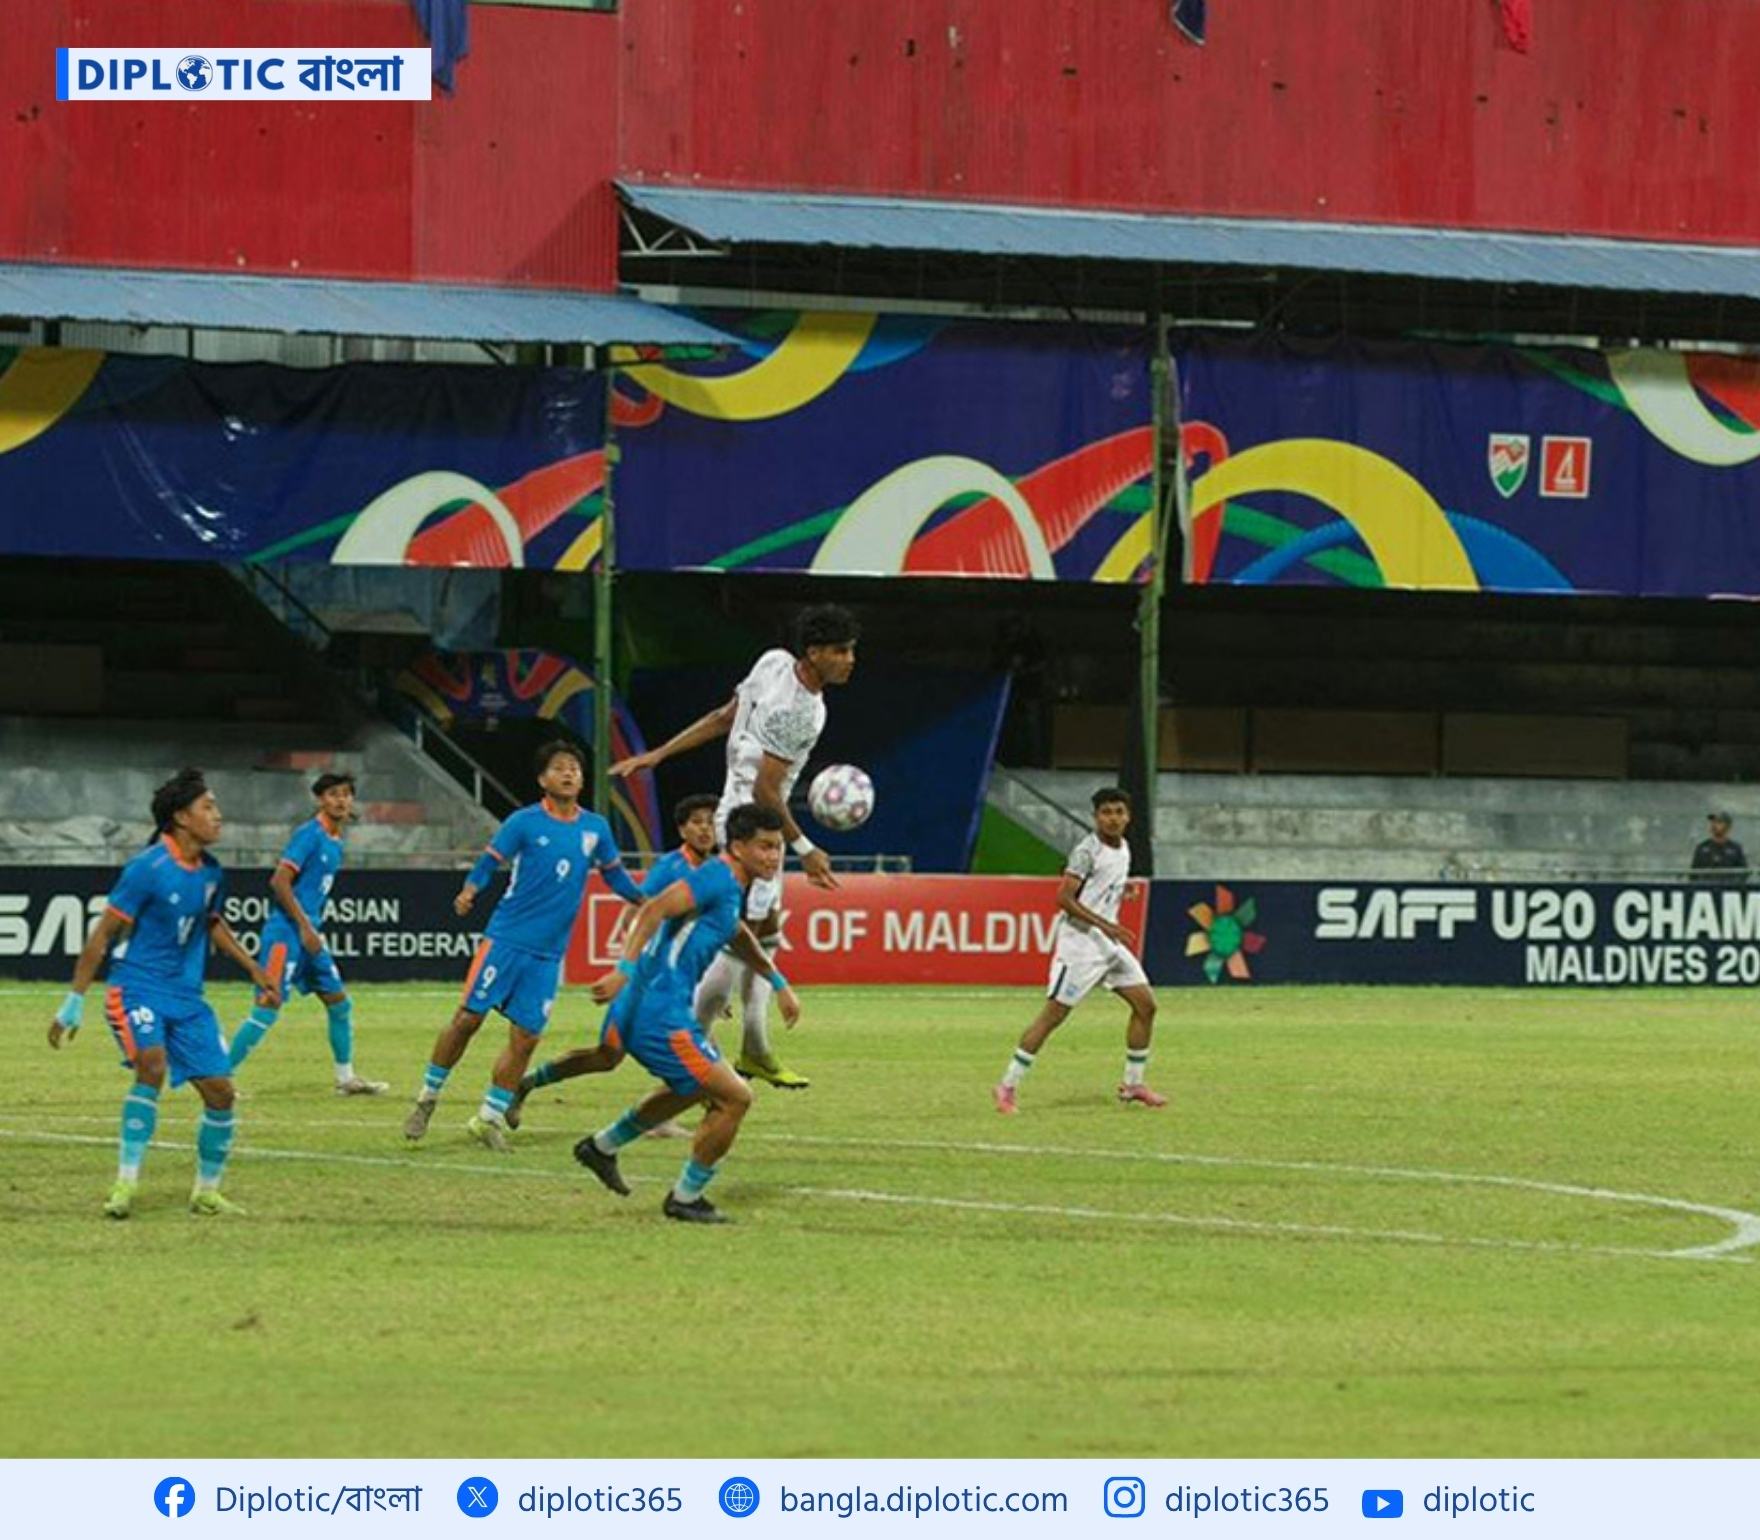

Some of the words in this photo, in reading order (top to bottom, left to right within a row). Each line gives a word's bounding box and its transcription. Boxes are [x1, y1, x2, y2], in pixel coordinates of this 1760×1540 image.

[556, 858, 570, 882] 9
[321, 898, 400, 923] ASIAN
[1315, 889, 1477, 938] SAFF
[1492, 890, 1596, 940] U20
[1613, 890, 1760, 940] CHAM
[367, 932, 483, 957] FEDERAT
[807, 908, 869, 952] OF
[883, 909, 1064, 953] MALDIV
[1526, 945, 1707, 983] MALDIVES
[1716, 946, 1760, 983] 20
